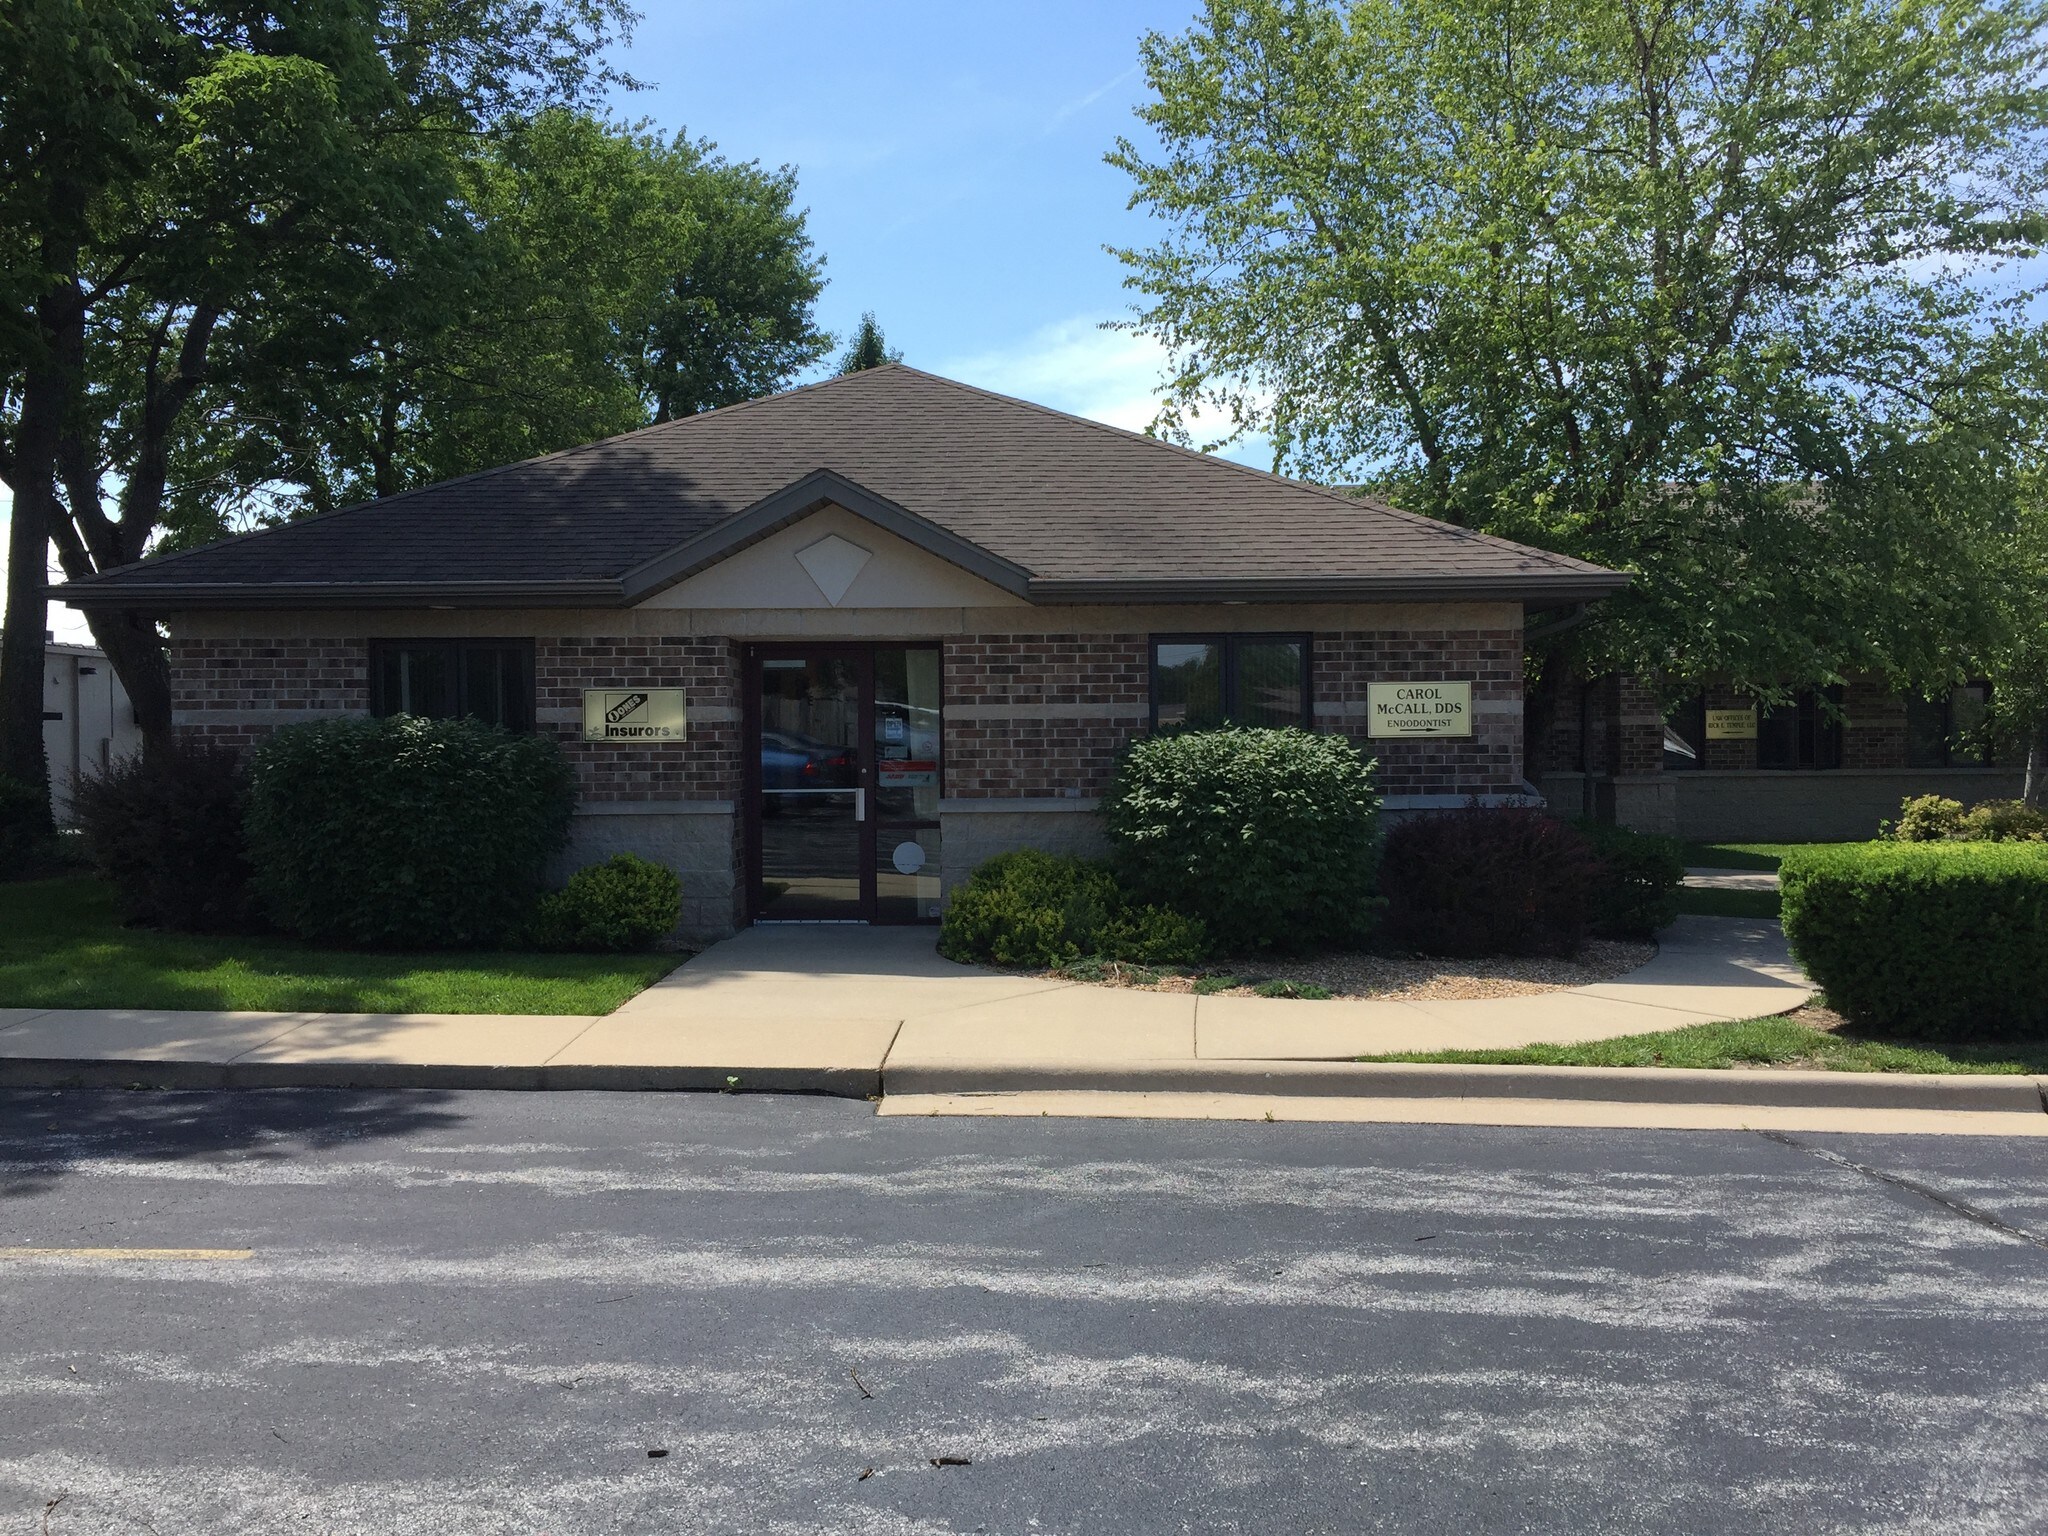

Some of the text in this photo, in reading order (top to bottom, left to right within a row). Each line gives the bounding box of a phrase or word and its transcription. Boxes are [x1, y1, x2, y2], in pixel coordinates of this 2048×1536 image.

[1396, 688, 1442, 700] CAROL
[608, 695, 641, 722] JONES
[1377, 702, 1462, 715] McCALL, DDS
[1387, 719, 1452, 727] ENDODONTIST
[605, 724, 670, 737] Insurors
